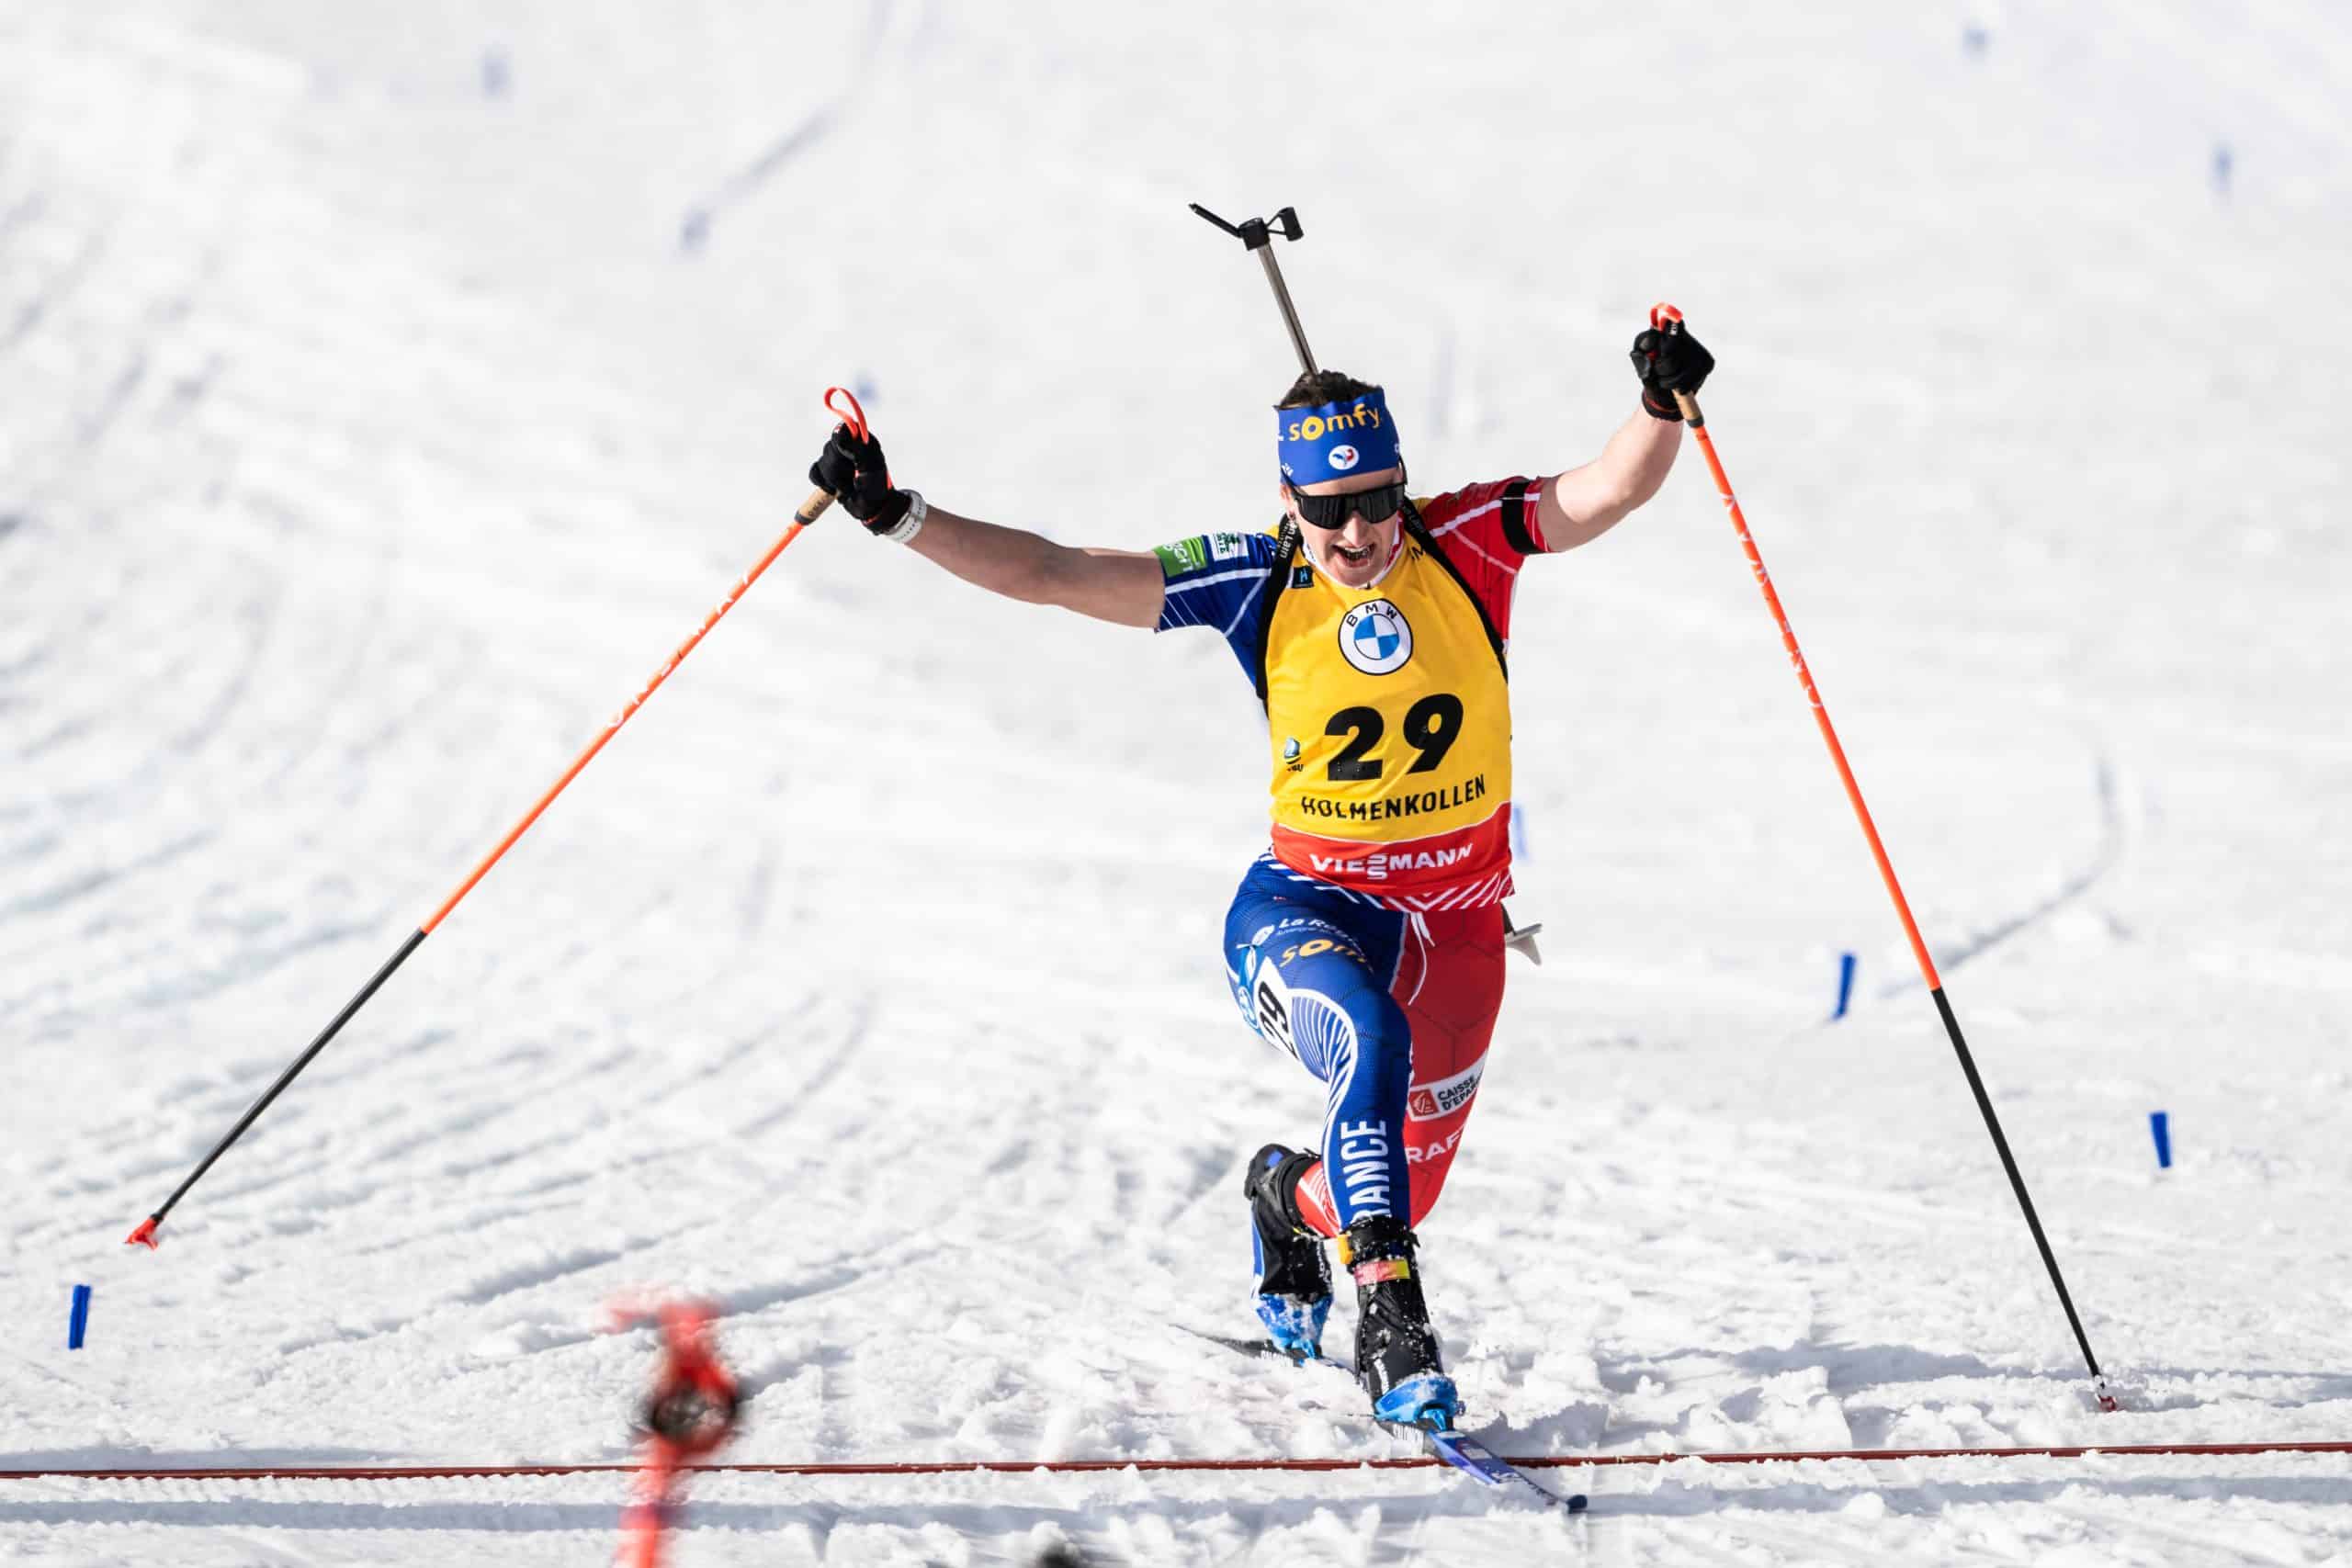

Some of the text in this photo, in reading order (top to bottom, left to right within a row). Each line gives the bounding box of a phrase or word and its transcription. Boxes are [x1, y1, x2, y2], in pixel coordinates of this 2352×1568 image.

[1289, 403, 1379, 441] somfy
[1346, 603, 1397, 627] BMW
[1324, 694, 1464, 781] 29
[1301, 774, 1486, 820] HOLMENKOLLEN
[1309, 842, 1473, 880] VIESSMANN
[1405, 1124, 1464, 1164] RAF
[1340, 1120, 1390, 1224] RANCE
